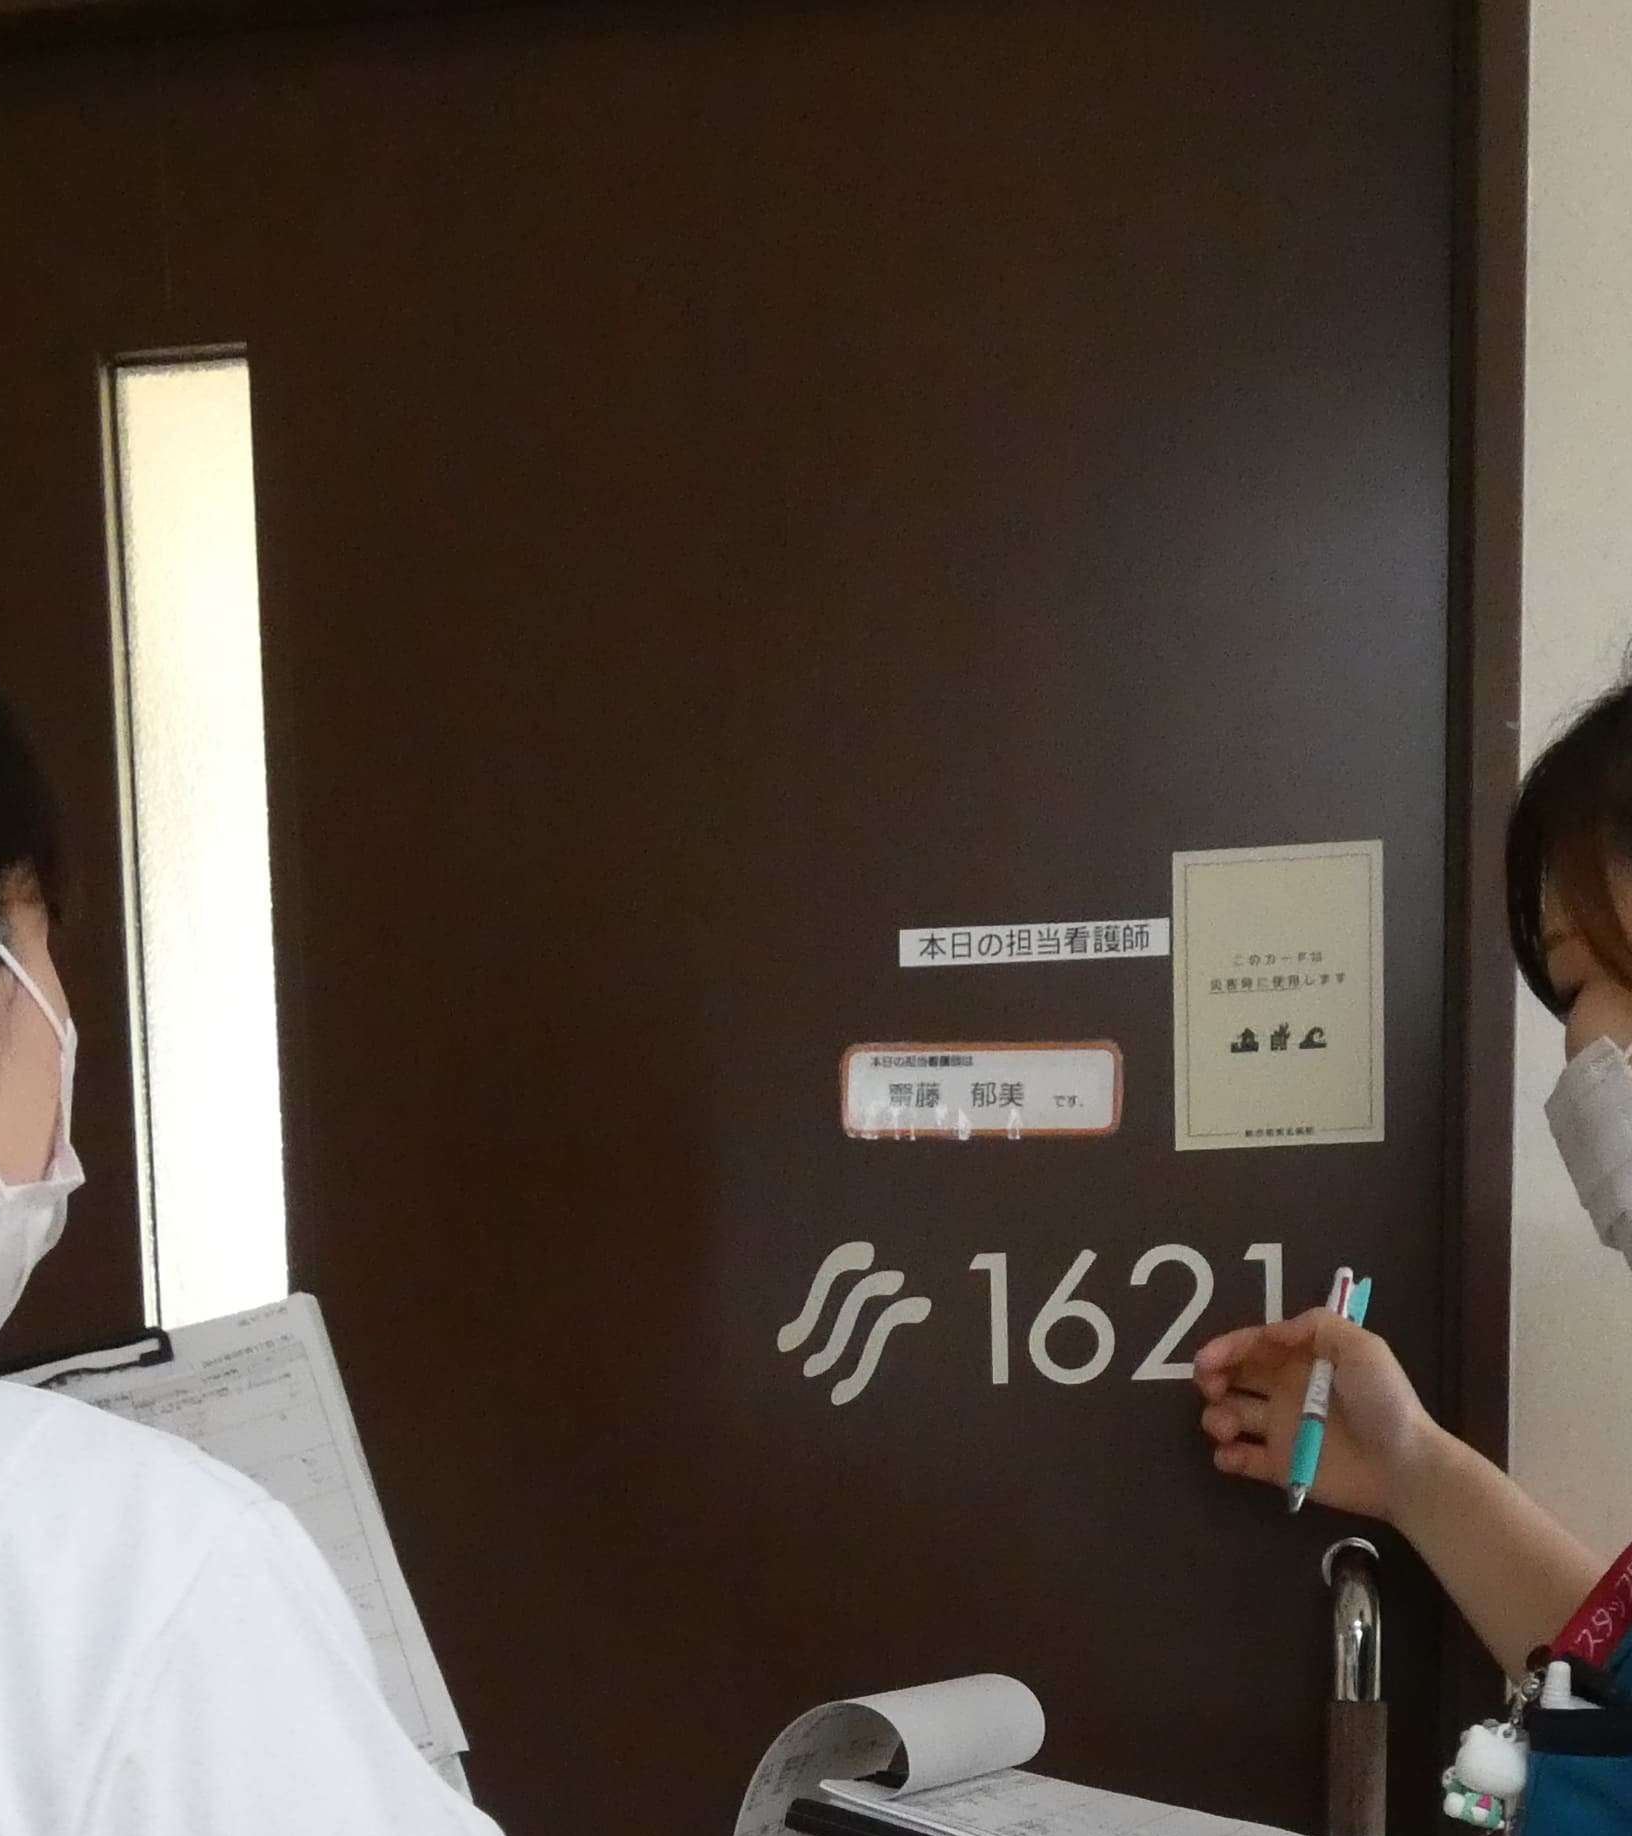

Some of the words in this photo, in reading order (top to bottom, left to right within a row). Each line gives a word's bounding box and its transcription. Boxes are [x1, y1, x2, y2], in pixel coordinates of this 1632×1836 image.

[918, 923, 1151, 961] 本日の担当看護師
[970, 1081, 1025, 1108] 郁美
[968, 1242, 1284, 1386] 1621
